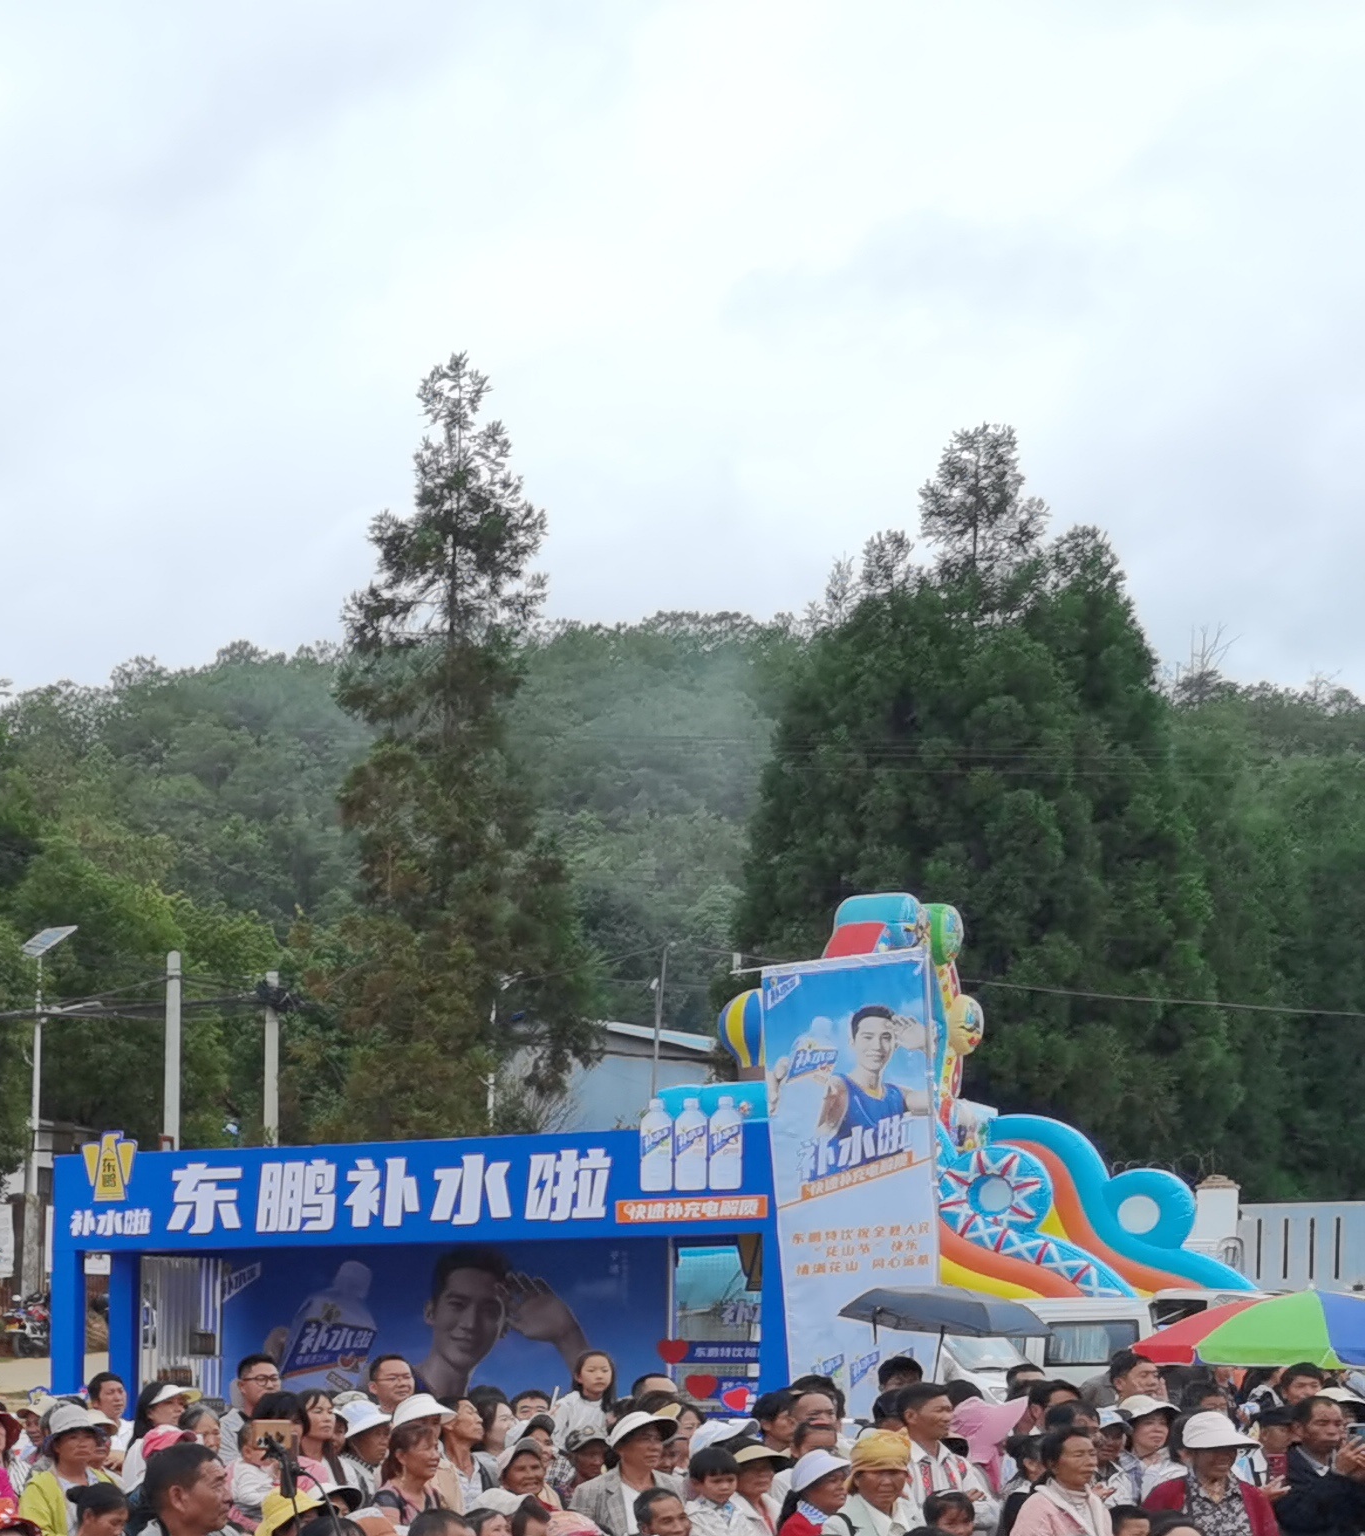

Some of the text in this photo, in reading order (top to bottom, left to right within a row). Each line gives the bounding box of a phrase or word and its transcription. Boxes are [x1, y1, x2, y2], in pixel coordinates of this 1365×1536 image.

[798, 1112, 914, 1183] 补水啦
[166, 1147, 613, 1235] 东鹏补水啦
[70, 1208, 152, 1237] 补水啦
[629, 1199, 759, 1220] 快速补充电解质
[300, 1324, 373, 1354] 补水啦
